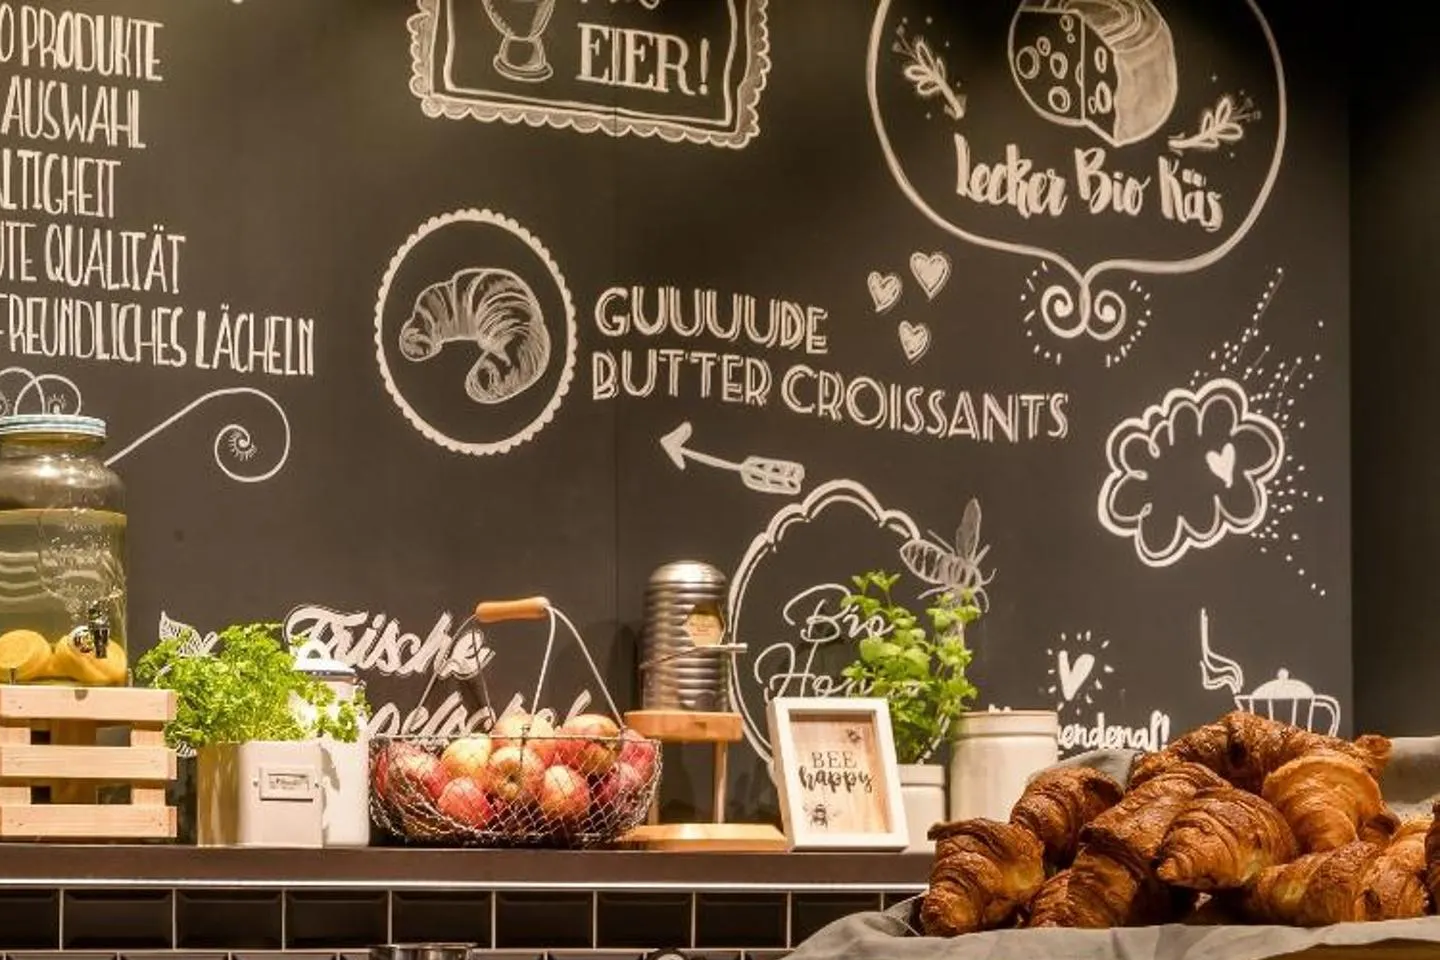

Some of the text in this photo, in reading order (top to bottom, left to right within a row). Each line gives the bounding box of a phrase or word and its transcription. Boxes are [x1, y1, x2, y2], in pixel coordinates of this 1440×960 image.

[21, 5, 164, 81] PRODUKTE
[575, 22, 710, 95] EIER!
[1, 75, 146, 149] AUSWAHL
[954, 133, 1068, 218] Lecker
[1074, 147, 1151, 216] Bio
[44, 224, 186, 294] QUALITÄT
[195, 303, 314, 376] LÄCHELN
[594, 287, 828, 355] GUUUUDE
[591, 347, 1069, 443] BUTTER CROISSANTS
[783, 583, 894, 642] Bio
[799, 765, 872, 793] happy
[812, 751, 856, 768] BEE
